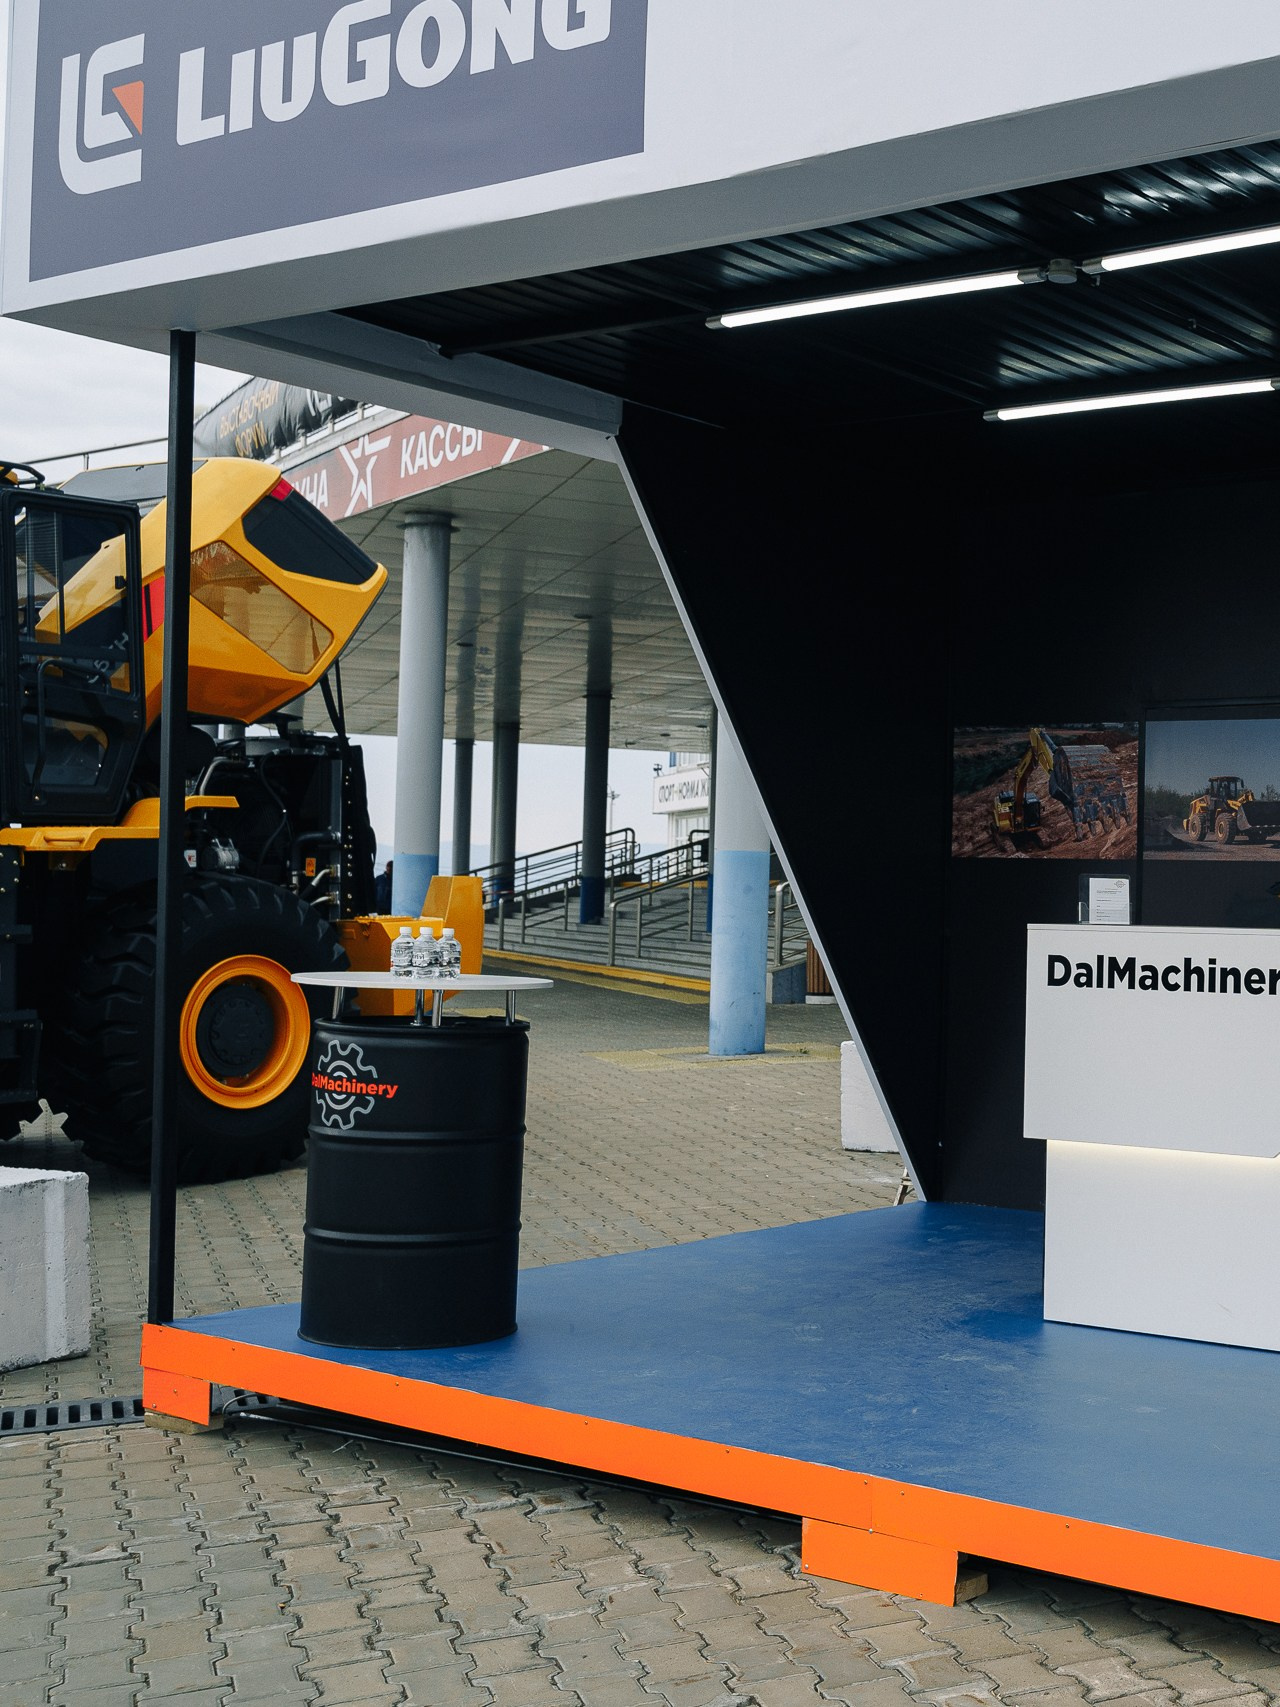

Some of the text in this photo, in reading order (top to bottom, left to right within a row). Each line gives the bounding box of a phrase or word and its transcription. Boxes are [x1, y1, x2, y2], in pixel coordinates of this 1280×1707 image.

[176, 0, 611, 146] LIUGONG
[234, 421, 268, 457] ФОРУМ
[400, 422, 483, 479] КАССЫ
